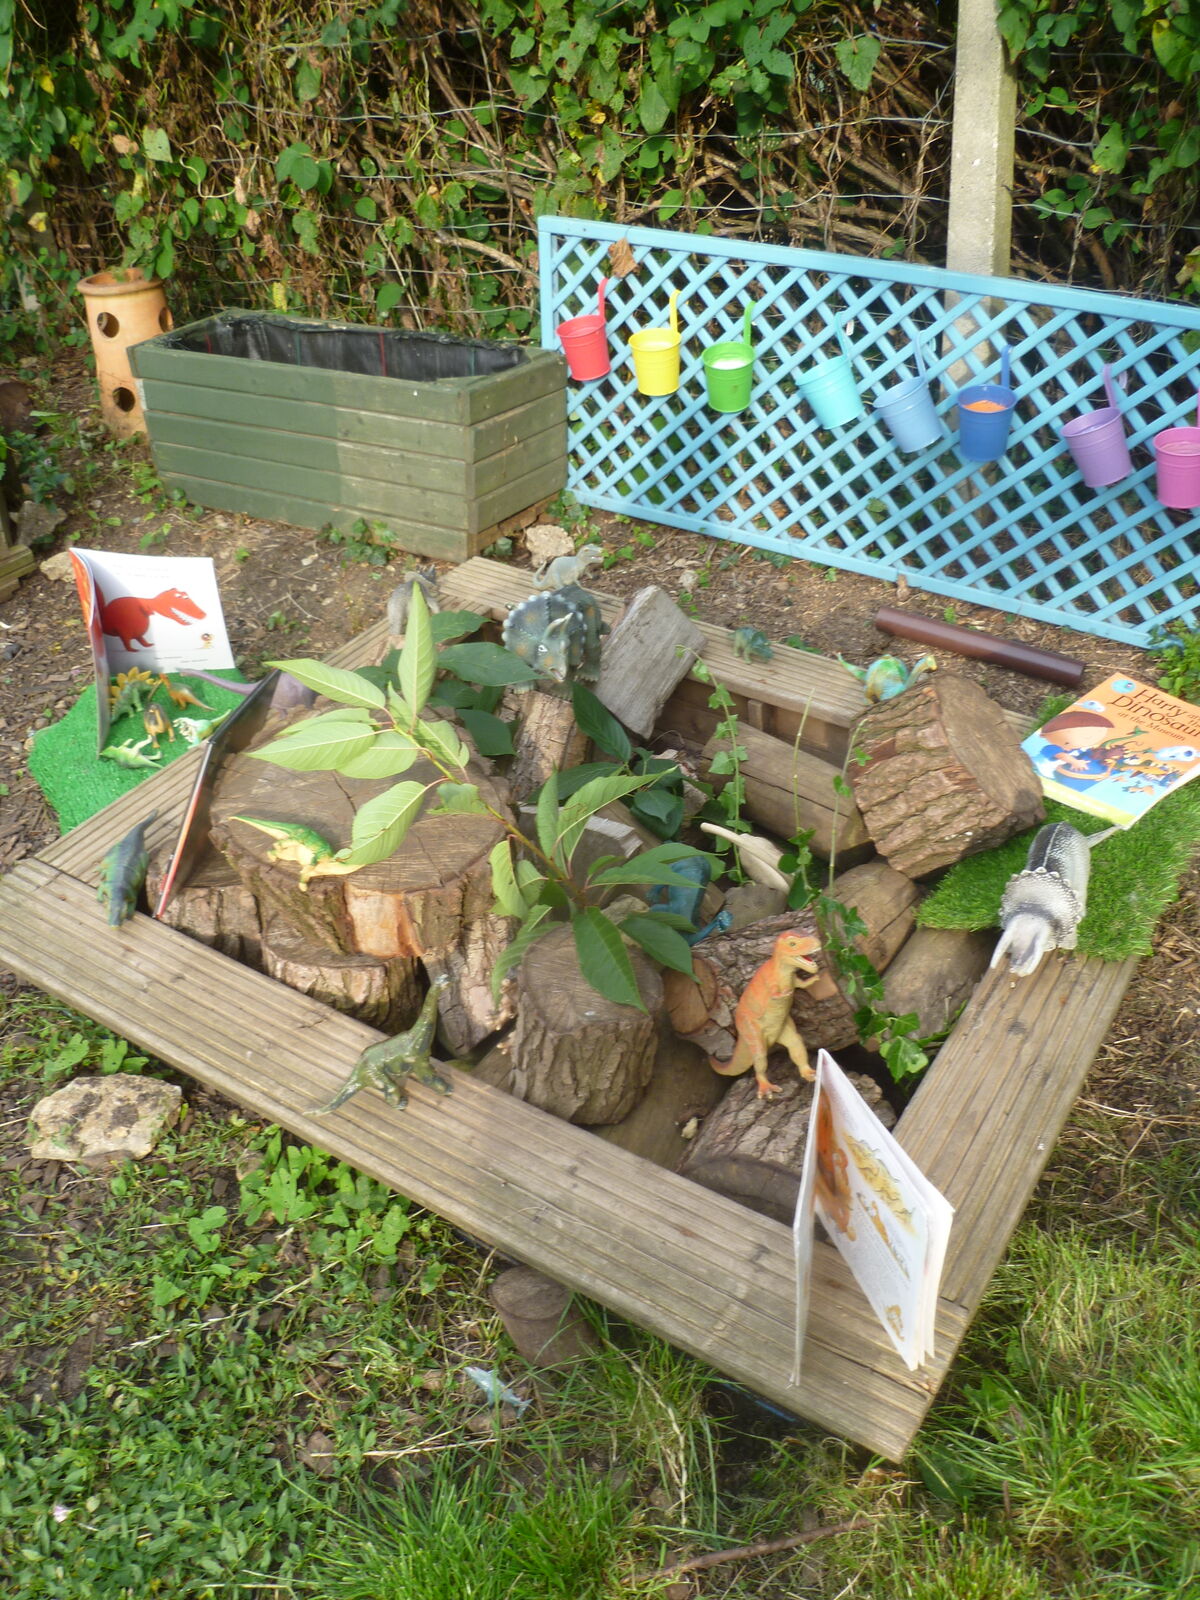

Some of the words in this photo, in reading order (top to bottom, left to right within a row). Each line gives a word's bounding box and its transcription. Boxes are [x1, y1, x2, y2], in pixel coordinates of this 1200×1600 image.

[1133, 689, 1187, 718] Harry
[1129, 716, 1146, 726] the
[1145, 722, 1186, 741] Museum
